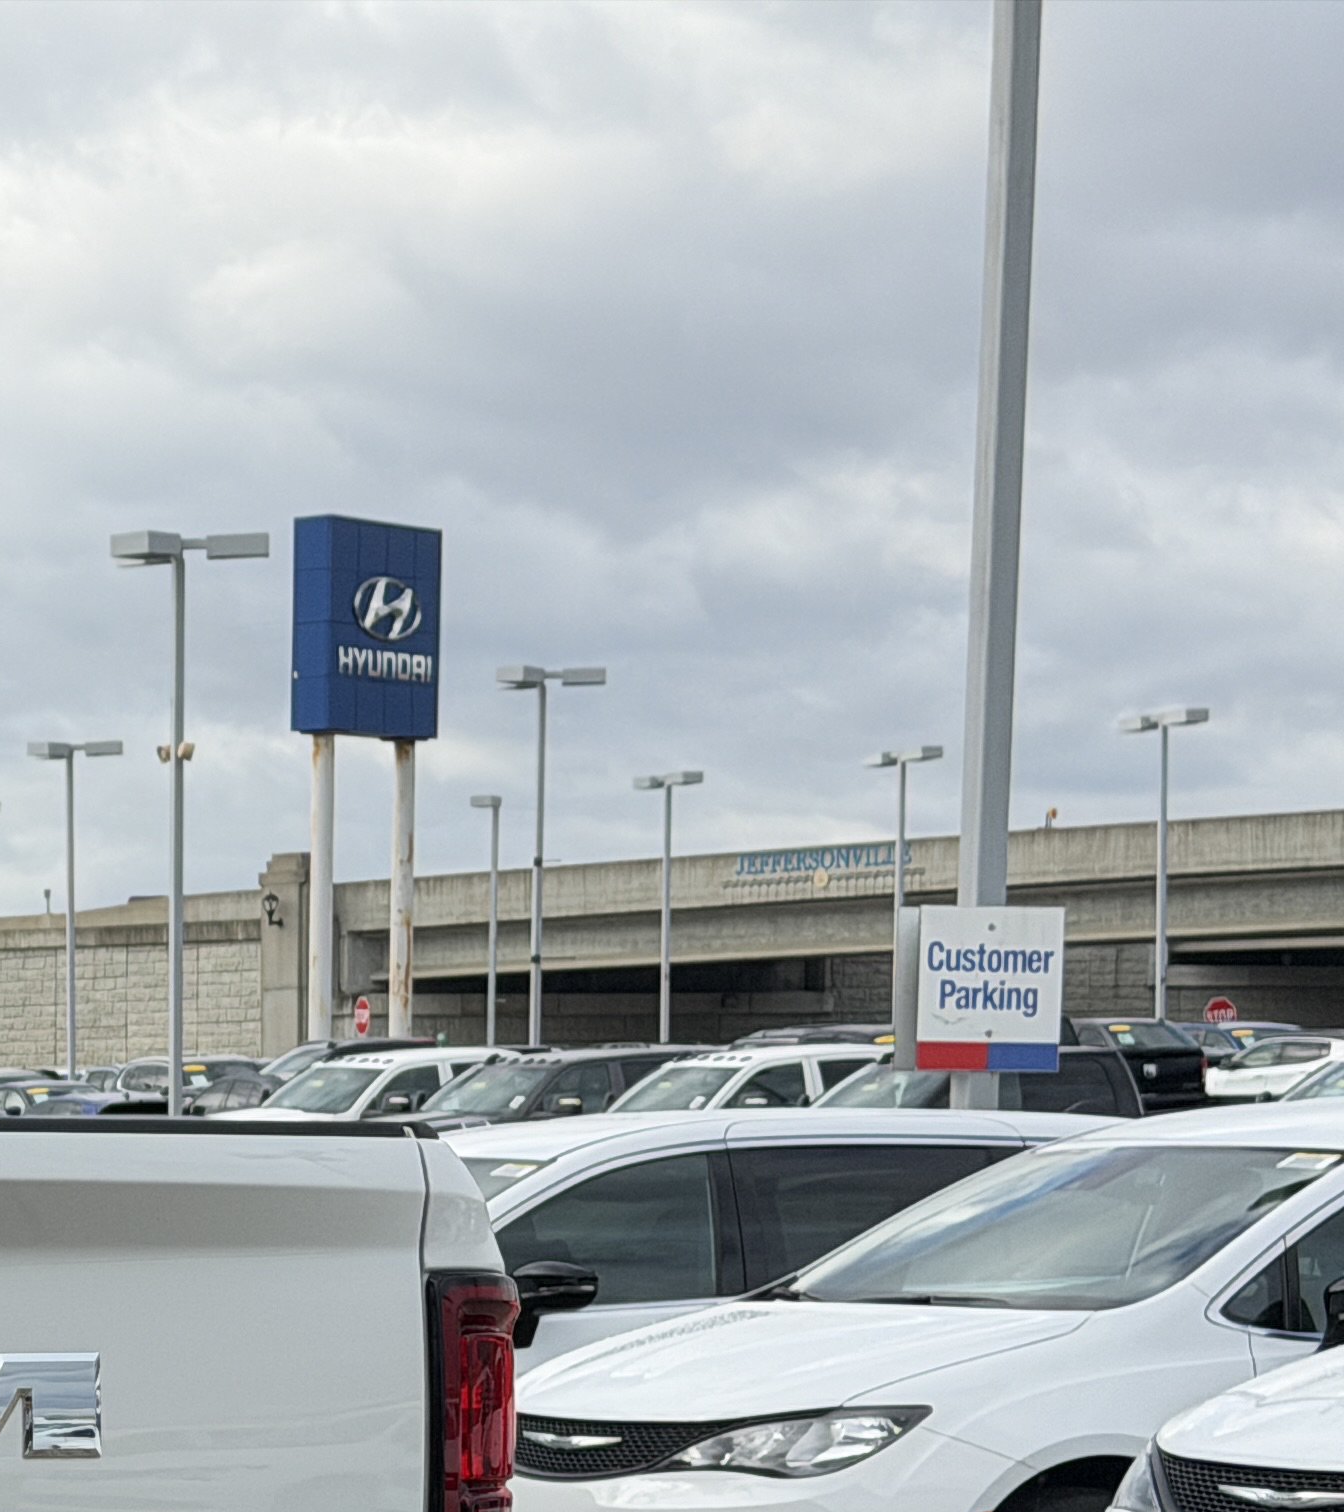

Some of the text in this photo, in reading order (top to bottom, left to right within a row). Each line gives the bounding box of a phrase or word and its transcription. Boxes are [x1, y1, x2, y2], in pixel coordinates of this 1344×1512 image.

[338, 645, 433, 683] HYUNDAI
[927, 941, 1055, 974] Customer
[938, 979, 1039, 1018] Parking
